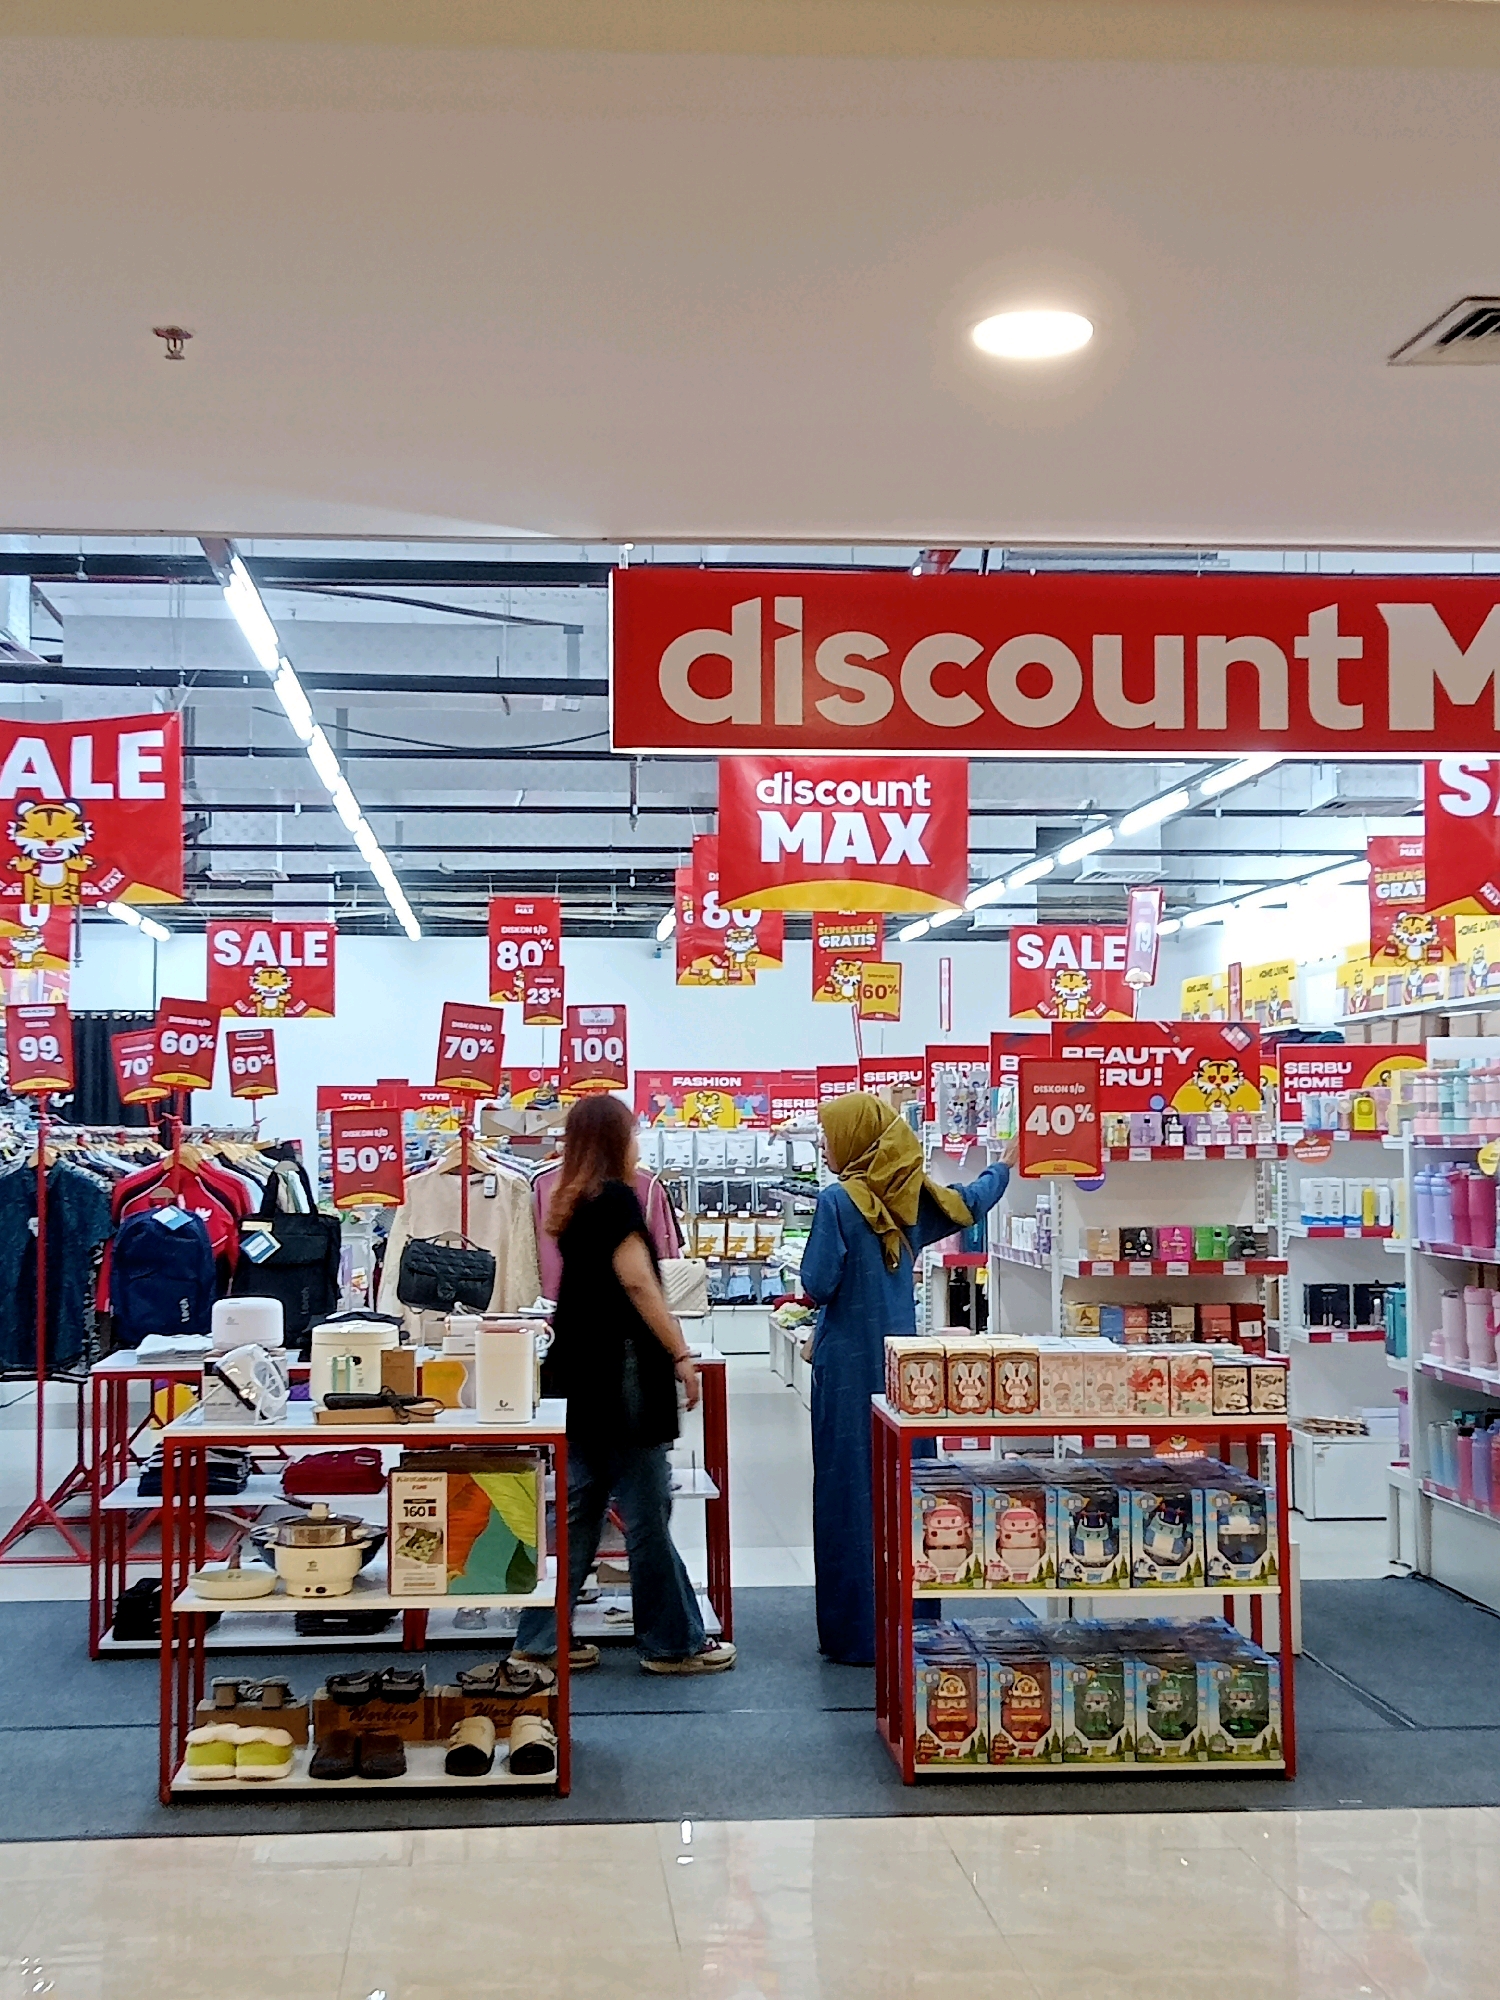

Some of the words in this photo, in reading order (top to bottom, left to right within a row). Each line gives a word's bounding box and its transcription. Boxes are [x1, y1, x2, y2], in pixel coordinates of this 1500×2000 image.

[0, 730, 166, 800] ALE
[756, 771, 931, 807] discount
[1438, 759, 1500, 817] S
[756, 810, 931, 865] MAX
[212, 930, 328, 967] SALE
[818, 933, 876, 948] GRATIS
[497, 938, 554, 971] 80%
[1016, 933, 1126, 971] SALE
[526, 987, 561, 1005] 23%
[862, 983, 899, 1000] 60%
[160, 1029, 215, 1056] 60%
[444, 1035, 495, 1062] 70%
[571, 1036, 624, 1063] 100
[231, 1053, 274, 1076] 60%
[863, 1068, 923, 1082] SERBU
[1283, 1062, 1352, 1074] SERBU
[672, 1076, 742, 1087] FASHION
[1099, 1067, 1163, 1087] RU!
[1283, 1076, 1344, 1088] HOME
[340, 1092, 372, 1101] TOYS
[419, 1092, 450, 1101] TOYS
[1033, 1084, 1069, 1094] DISKON
[771, 1098, 818, 1109] SERB
[1025, 1103, 1096, 1136] 40%
[336, 1145, 398, 1174] 50%
[403, 1506, 426, 1518] 160
